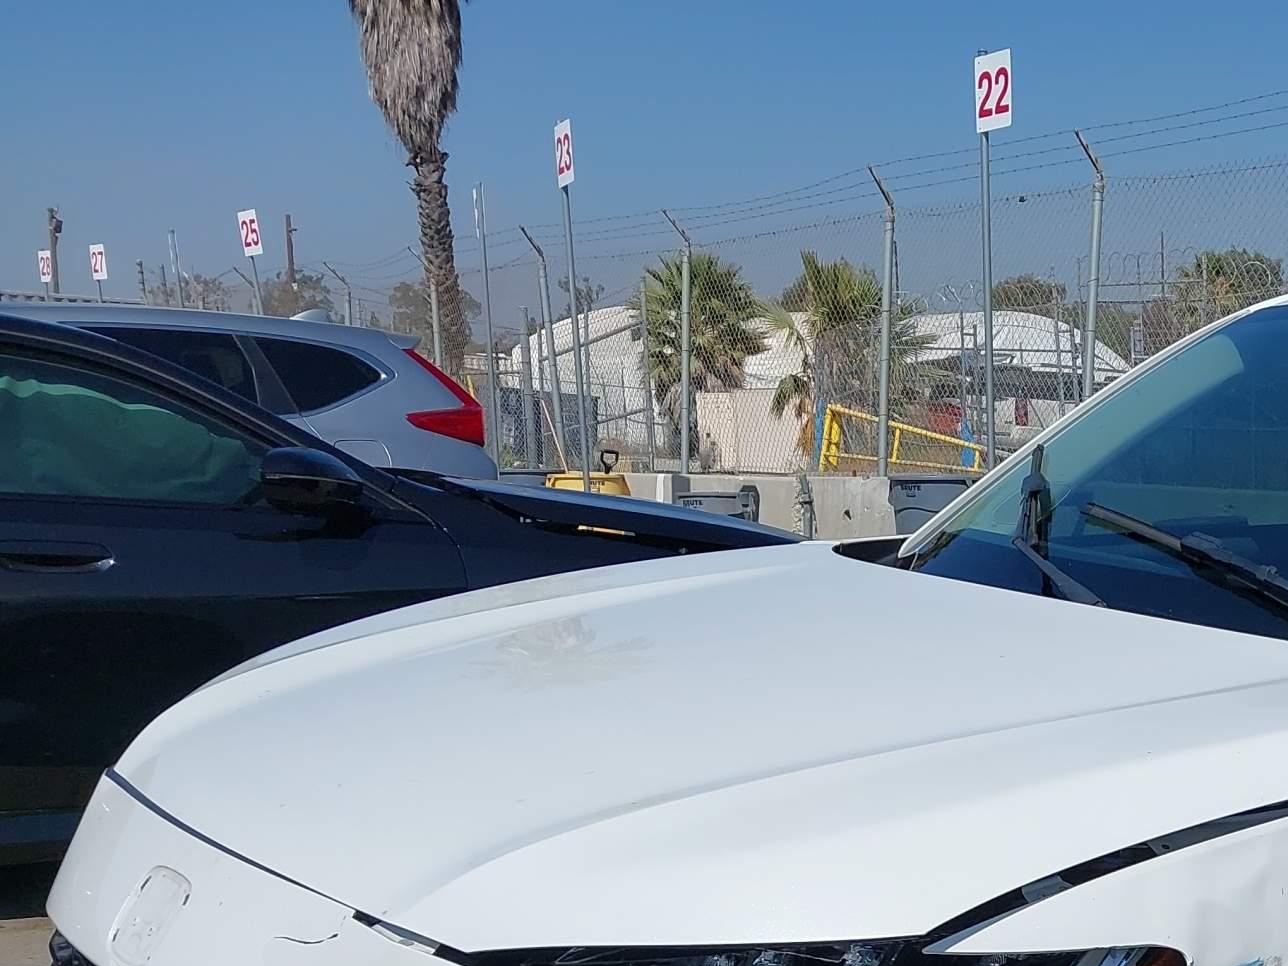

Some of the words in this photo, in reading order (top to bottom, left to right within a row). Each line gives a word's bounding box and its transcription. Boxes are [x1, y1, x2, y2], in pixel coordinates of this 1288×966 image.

[977, 66, 1009, 118] 22
[556, 133, 572, 176] 23
[240, 218, 260, 248] 25
[40, 255, 51, 276] 28
[91, 251, 104, 273] 27
